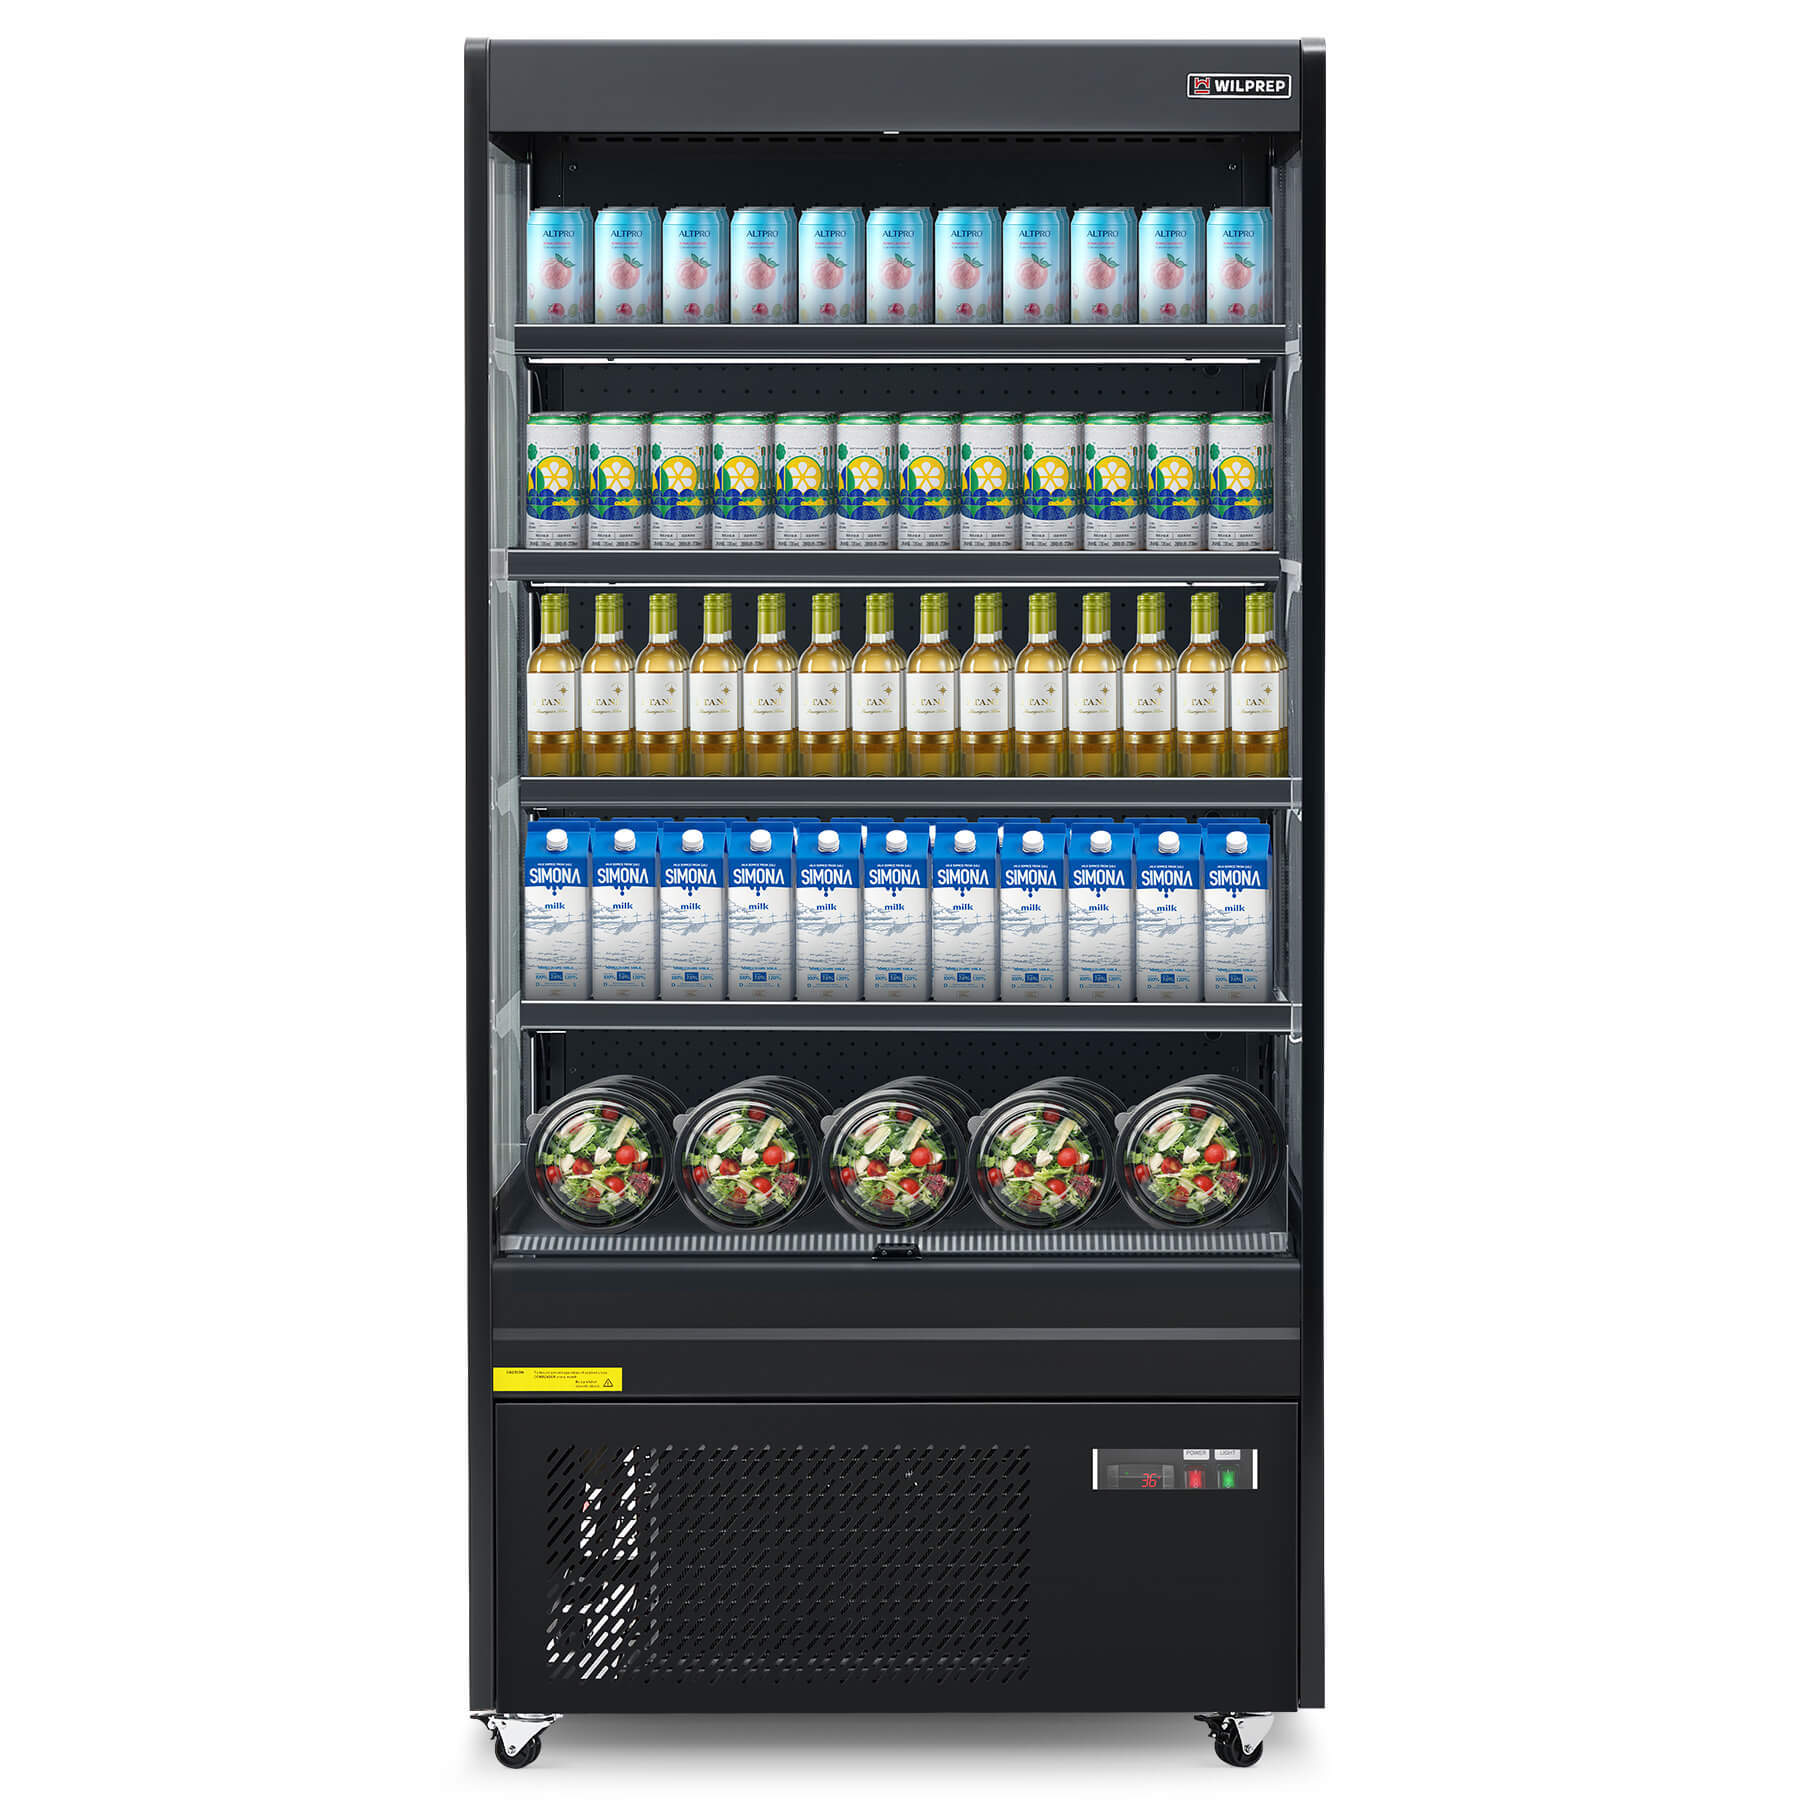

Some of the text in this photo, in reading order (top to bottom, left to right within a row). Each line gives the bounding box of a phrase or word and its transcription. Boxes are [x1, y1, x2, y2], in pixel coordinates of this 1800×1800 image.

[1214, 79, 1286, 93] WILPREP
[542, 230, 575, 238] ALTPRO
[610, 230, 643, 238] ALTPRO
[678, 230, 711, 238] ALTPRO
[746, 230, 779, 238] ALTPRO
[814, 230, 847, 238] ALTPRO
[882, 230, 915, 238] ALTPRO
[950, 230, 983, 238] ALTPRO
[1018, 230, 1051, 238] ALTPRO
[1086, 230, 1119, 238] ALTPRO
[1154, 230, 1187, 238] ALTPRO
[1222, 230, 1255, 238] ALTPRO
[544, 901, 566, 910] milk
[612, 901, 634, 910] milk
[680, 902, 702, 911] milk
[748, 902, 770, 911] milk
[816, 902, 838, 911] milk
[884, 902, 906, 911] milk
[952, 902, 974, 911] milk
[1020, 903, 1042, 912] milk
[1088, 903, 1110, 912] milk
[1156, 903, 1178, 912] milk
[1224, 903, 1246, 912] milk
